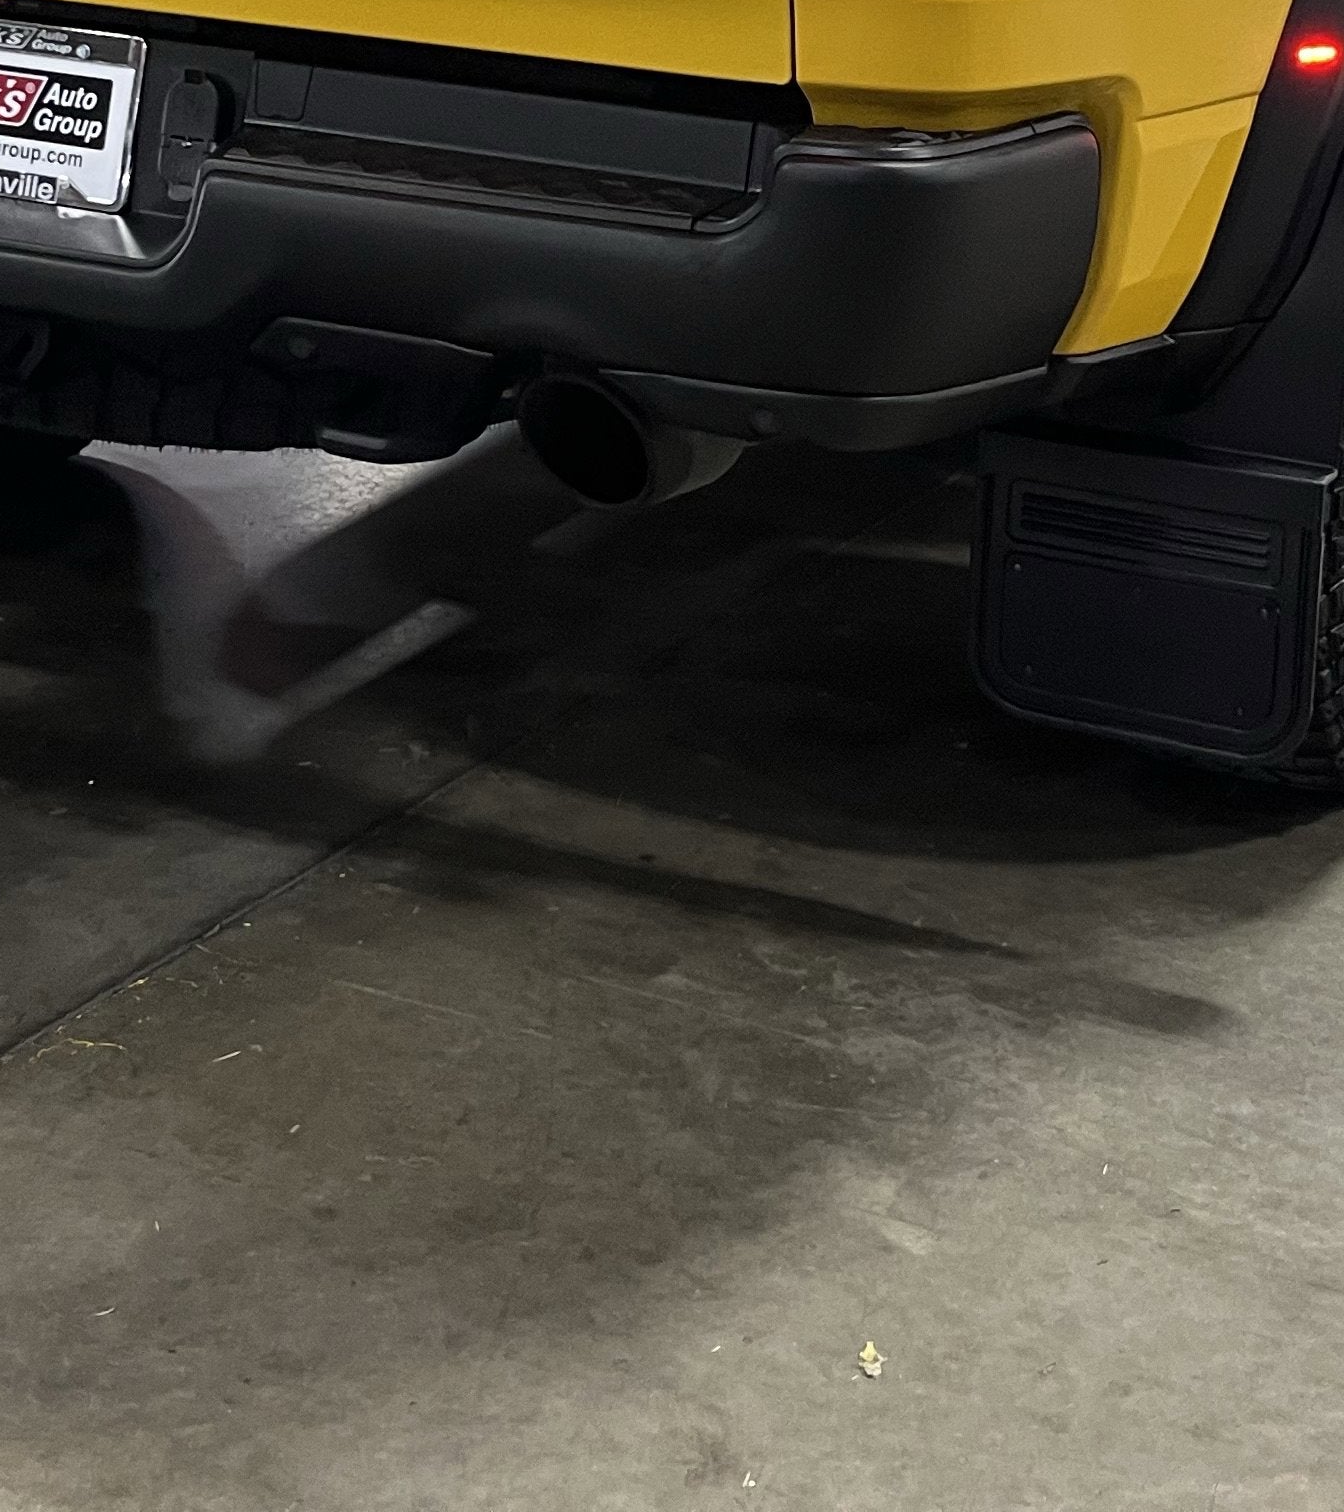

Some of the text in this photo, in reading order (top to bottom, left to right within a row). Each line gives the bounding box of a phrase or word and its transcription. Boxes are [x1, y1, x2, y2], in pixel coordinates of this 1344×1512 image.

[36, 29, 69, 42] Auto
[31, 39, 72, 54] Group
[43, 83, 98, 110] Auto
[33, 108, 103, 143] Group
